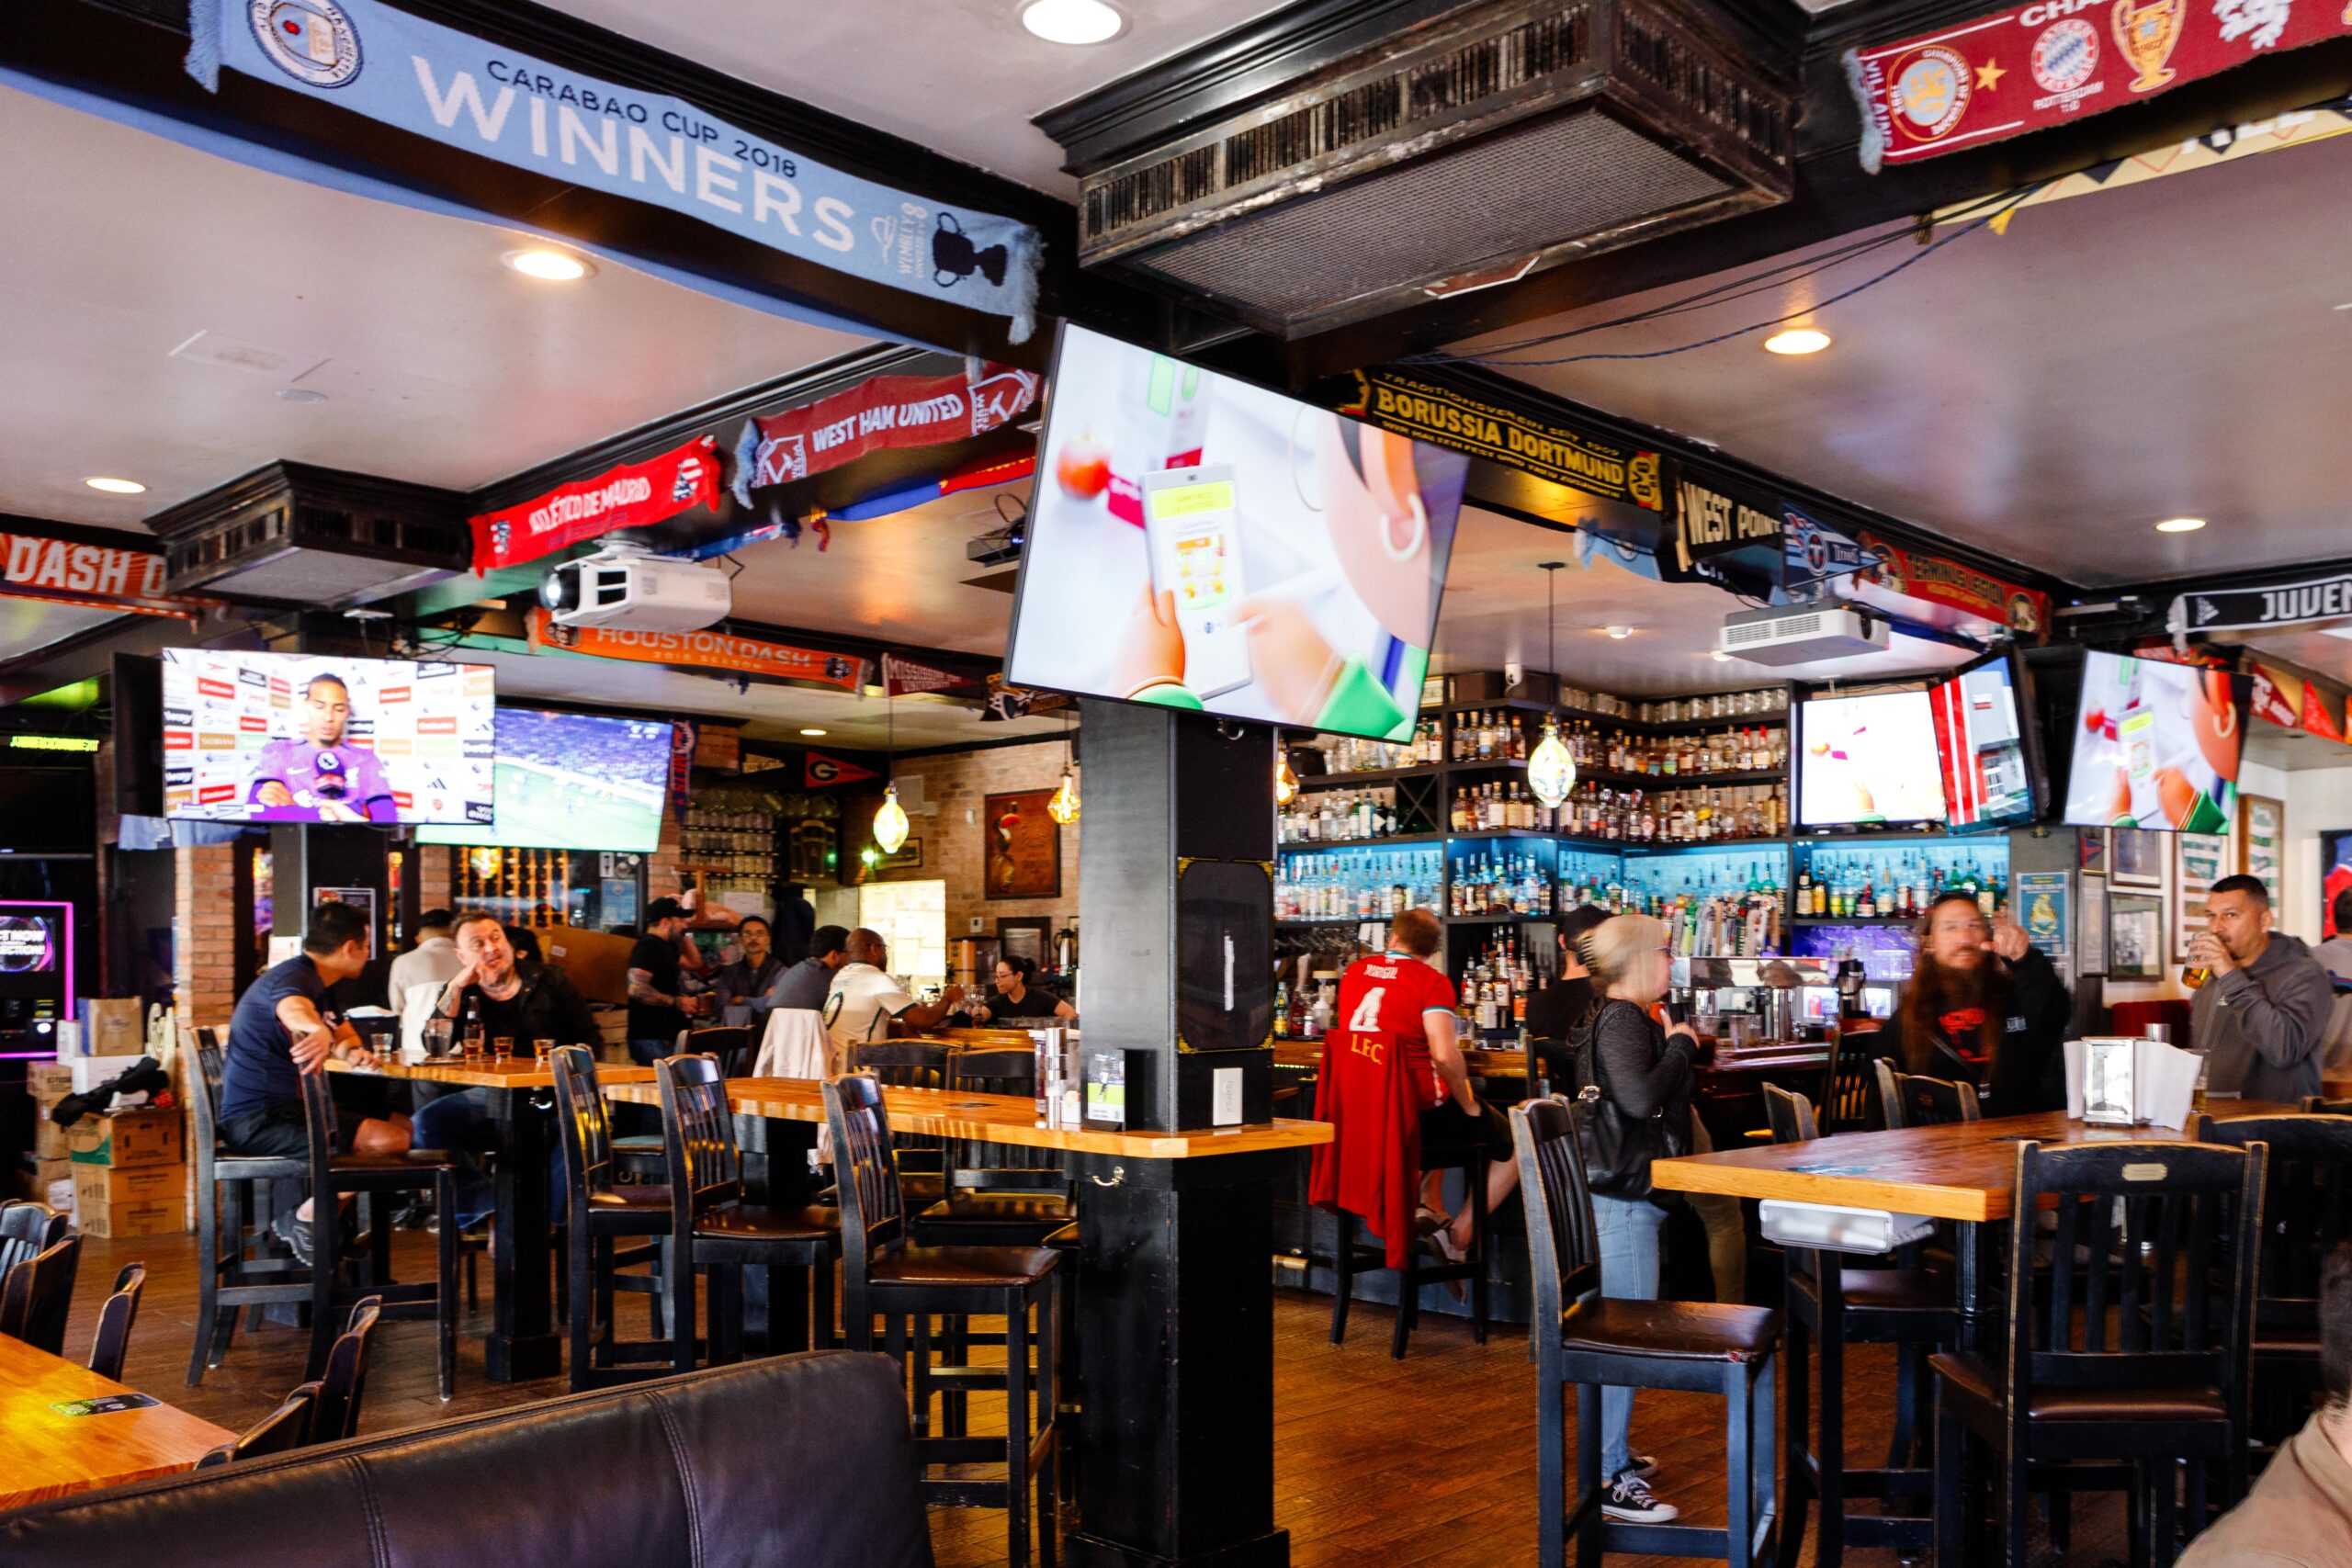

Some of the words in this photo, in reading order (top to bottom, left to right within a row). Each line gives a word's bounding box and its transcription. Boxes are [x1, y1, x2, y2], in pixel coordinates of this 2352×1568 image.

[2019, 0, 2108, 27] CHA
[486, 60, 648, 124] CARABAO
[662, 111, 719, 143] CUP
[734, 140, 797, 179] 2018
[411, 55, 856, 253] WINNERS
[811, 415, 856, 452] WEST
[858, 404, 897, 436] HAM
[898, 395, 964, 428] UNITED
[1376, 386, 1504, 446] BORUSSIA
[1508, 425, 1626, 485] DORTMUND
[582, 490, 601, 518] DE
[600, 476, 652, 512] MADRID
[1682, 480, 1733, 545] WEST
[1736, 504, 1782, 540] POINT
[4, 535, 132, 595] DASH
[595, 627, 735, 657] HOUSTON
[739, 641, 812, 668] DASH
[1348, 987, 1386, 1032] 4
